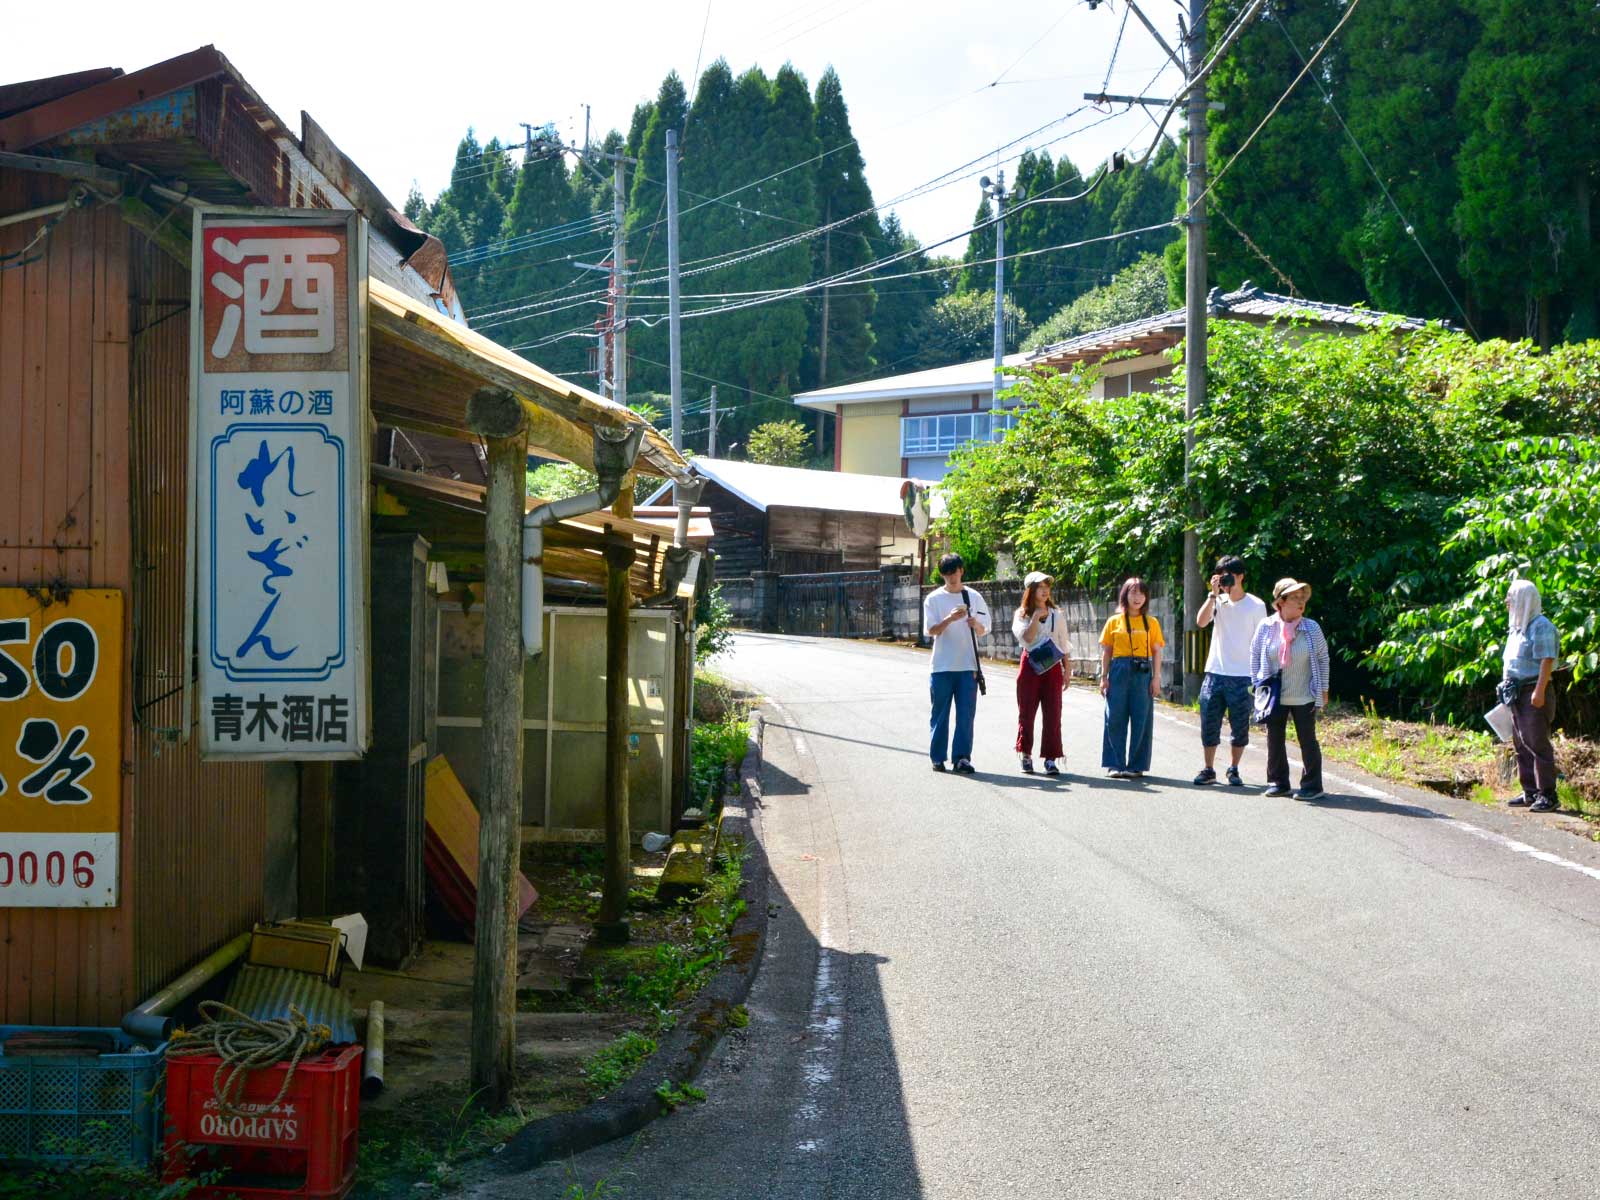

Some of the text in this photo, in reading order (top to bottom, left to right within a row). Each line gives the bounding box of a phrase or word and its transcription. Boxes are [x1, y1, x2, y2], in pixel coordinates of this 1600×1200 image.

[211, 237, 341, 359] 酒
[220, 389, 333, 415] 阿蘇の酒
[211, 693, 348, 742] 青木酒店
[200, 1113, 298, 1140] SAPPORO
